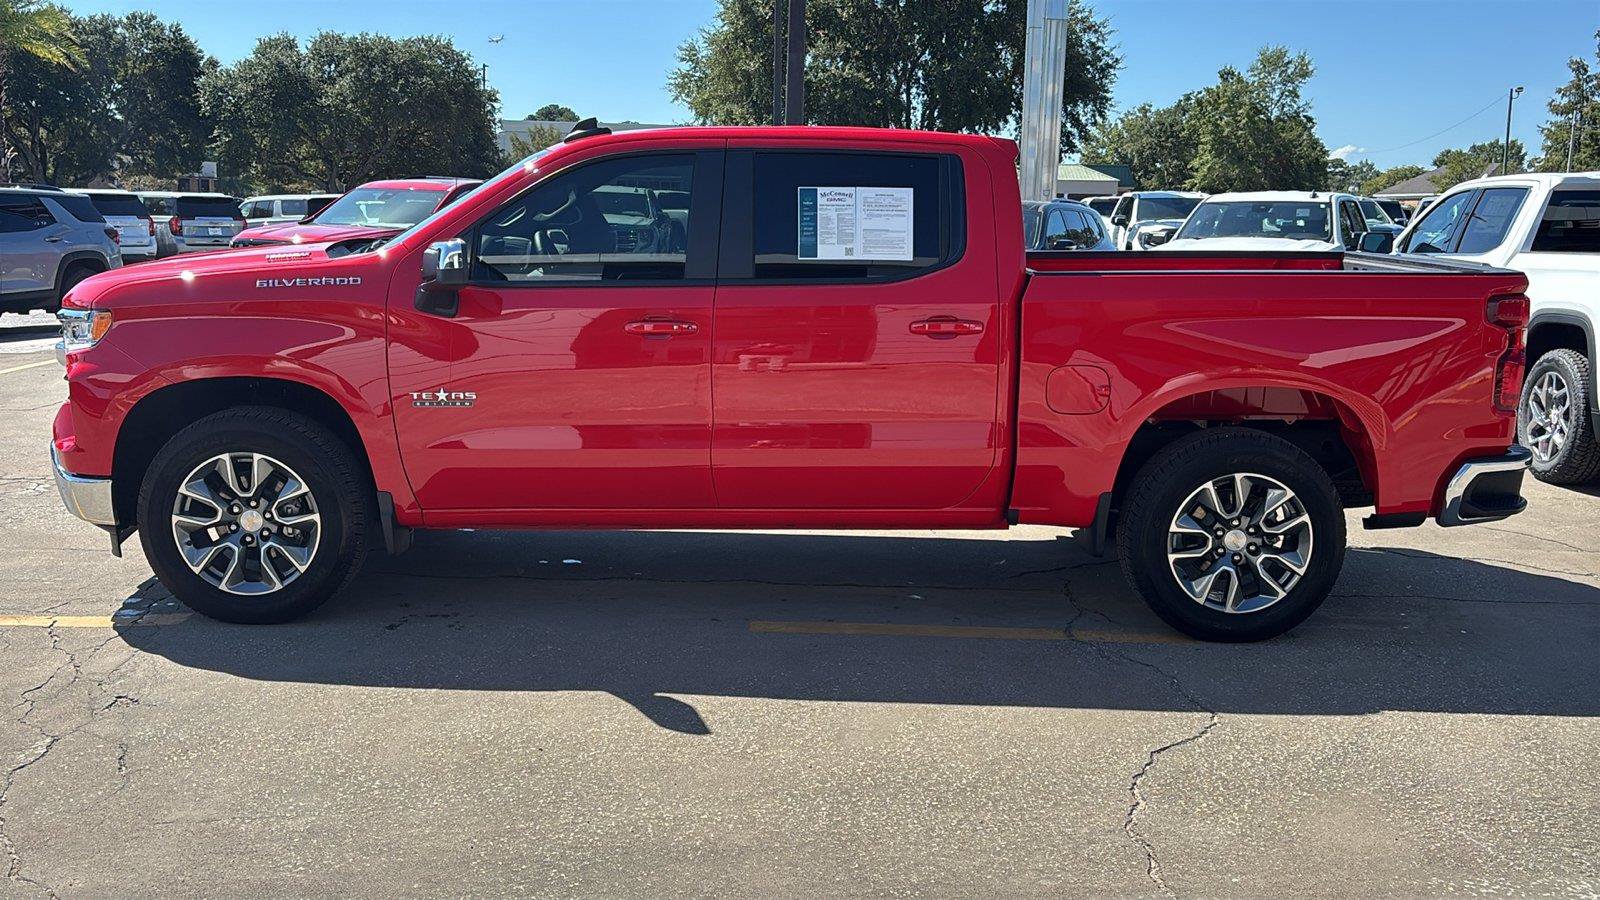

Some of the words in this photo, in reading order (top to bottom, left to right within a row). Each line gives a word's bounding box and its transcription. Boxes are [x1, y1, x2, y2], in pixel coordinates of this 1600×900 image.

[820, 190, 853, 198] McConnell
[256, 276, 362, 288] SILVERADO
[409, 388, 477, 401] TEXAS
